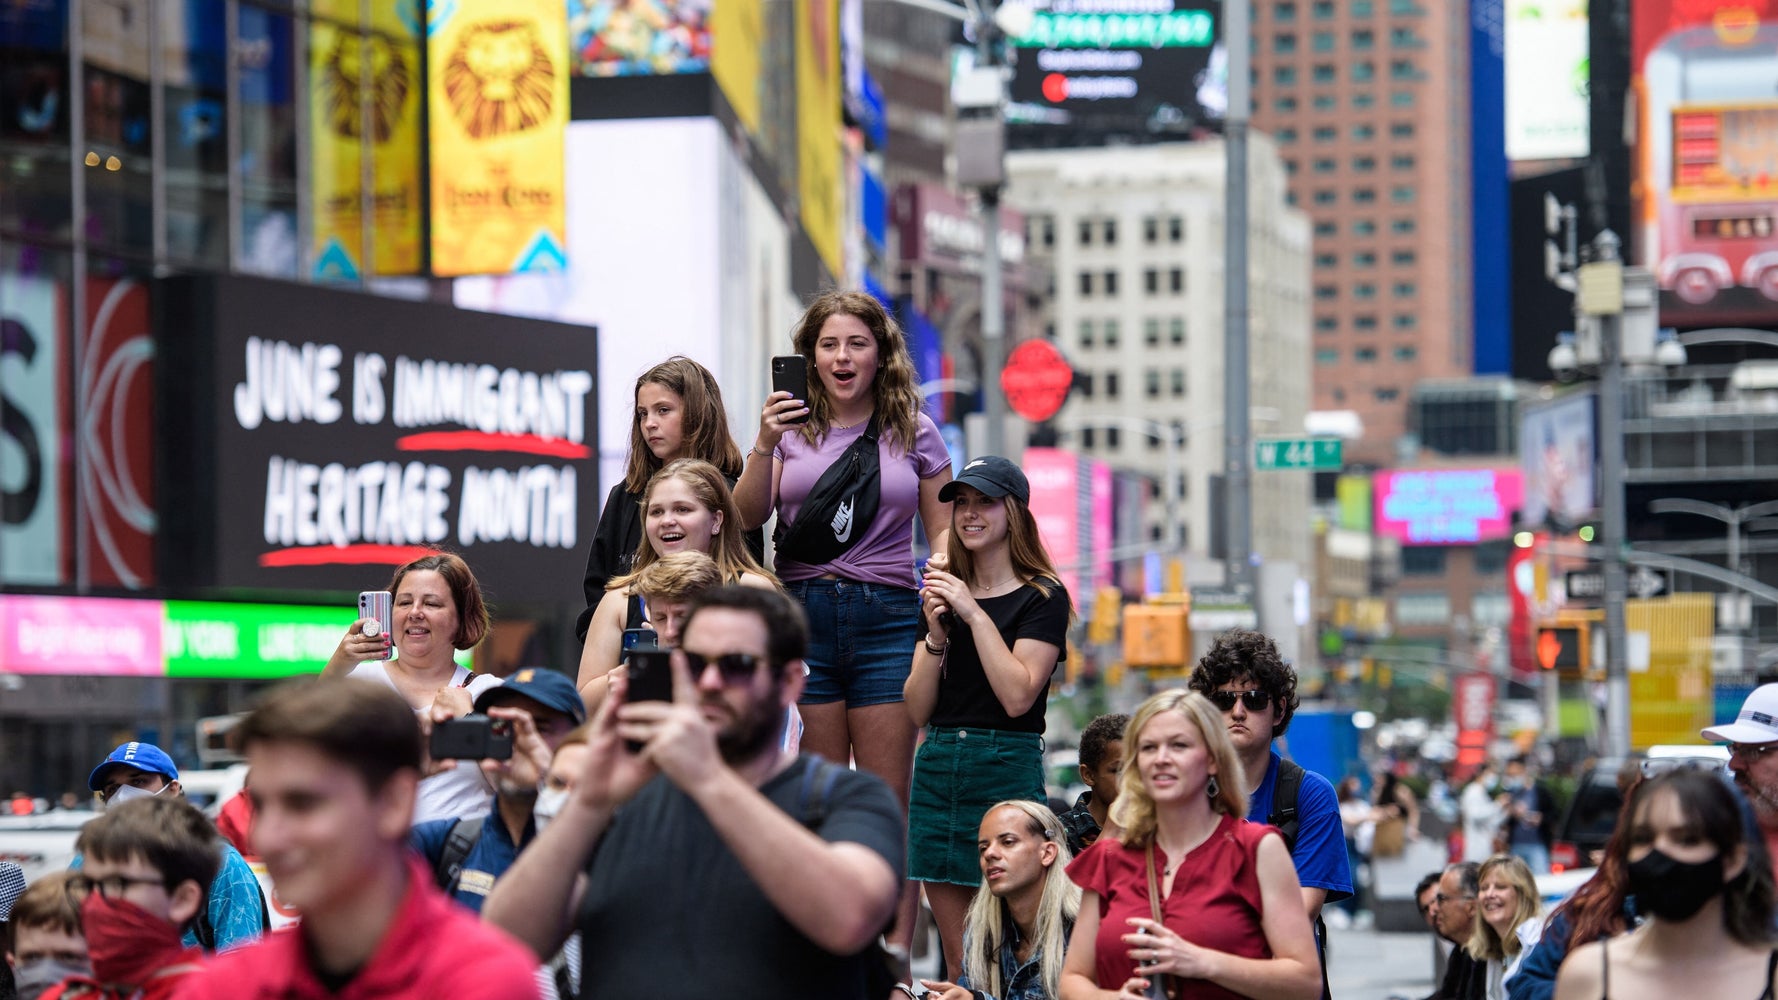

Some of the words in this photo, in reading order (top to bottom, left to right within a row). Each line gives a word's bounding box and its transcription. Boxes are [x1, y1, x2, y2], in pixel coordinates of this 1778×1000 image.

[234, 336, 342, 430] JUNE
[353, 352, 387, 424] IS
[393, 355, 593, 445] IMMIGRANT
[1260, 443, 1277, 465] W
[1284, 441, 1315, 467] 44
[264, 455, 452, 549] HERITAGE
[457, 464, 578, 549] MONTH
[831, 500, 851, 535] NIKE
